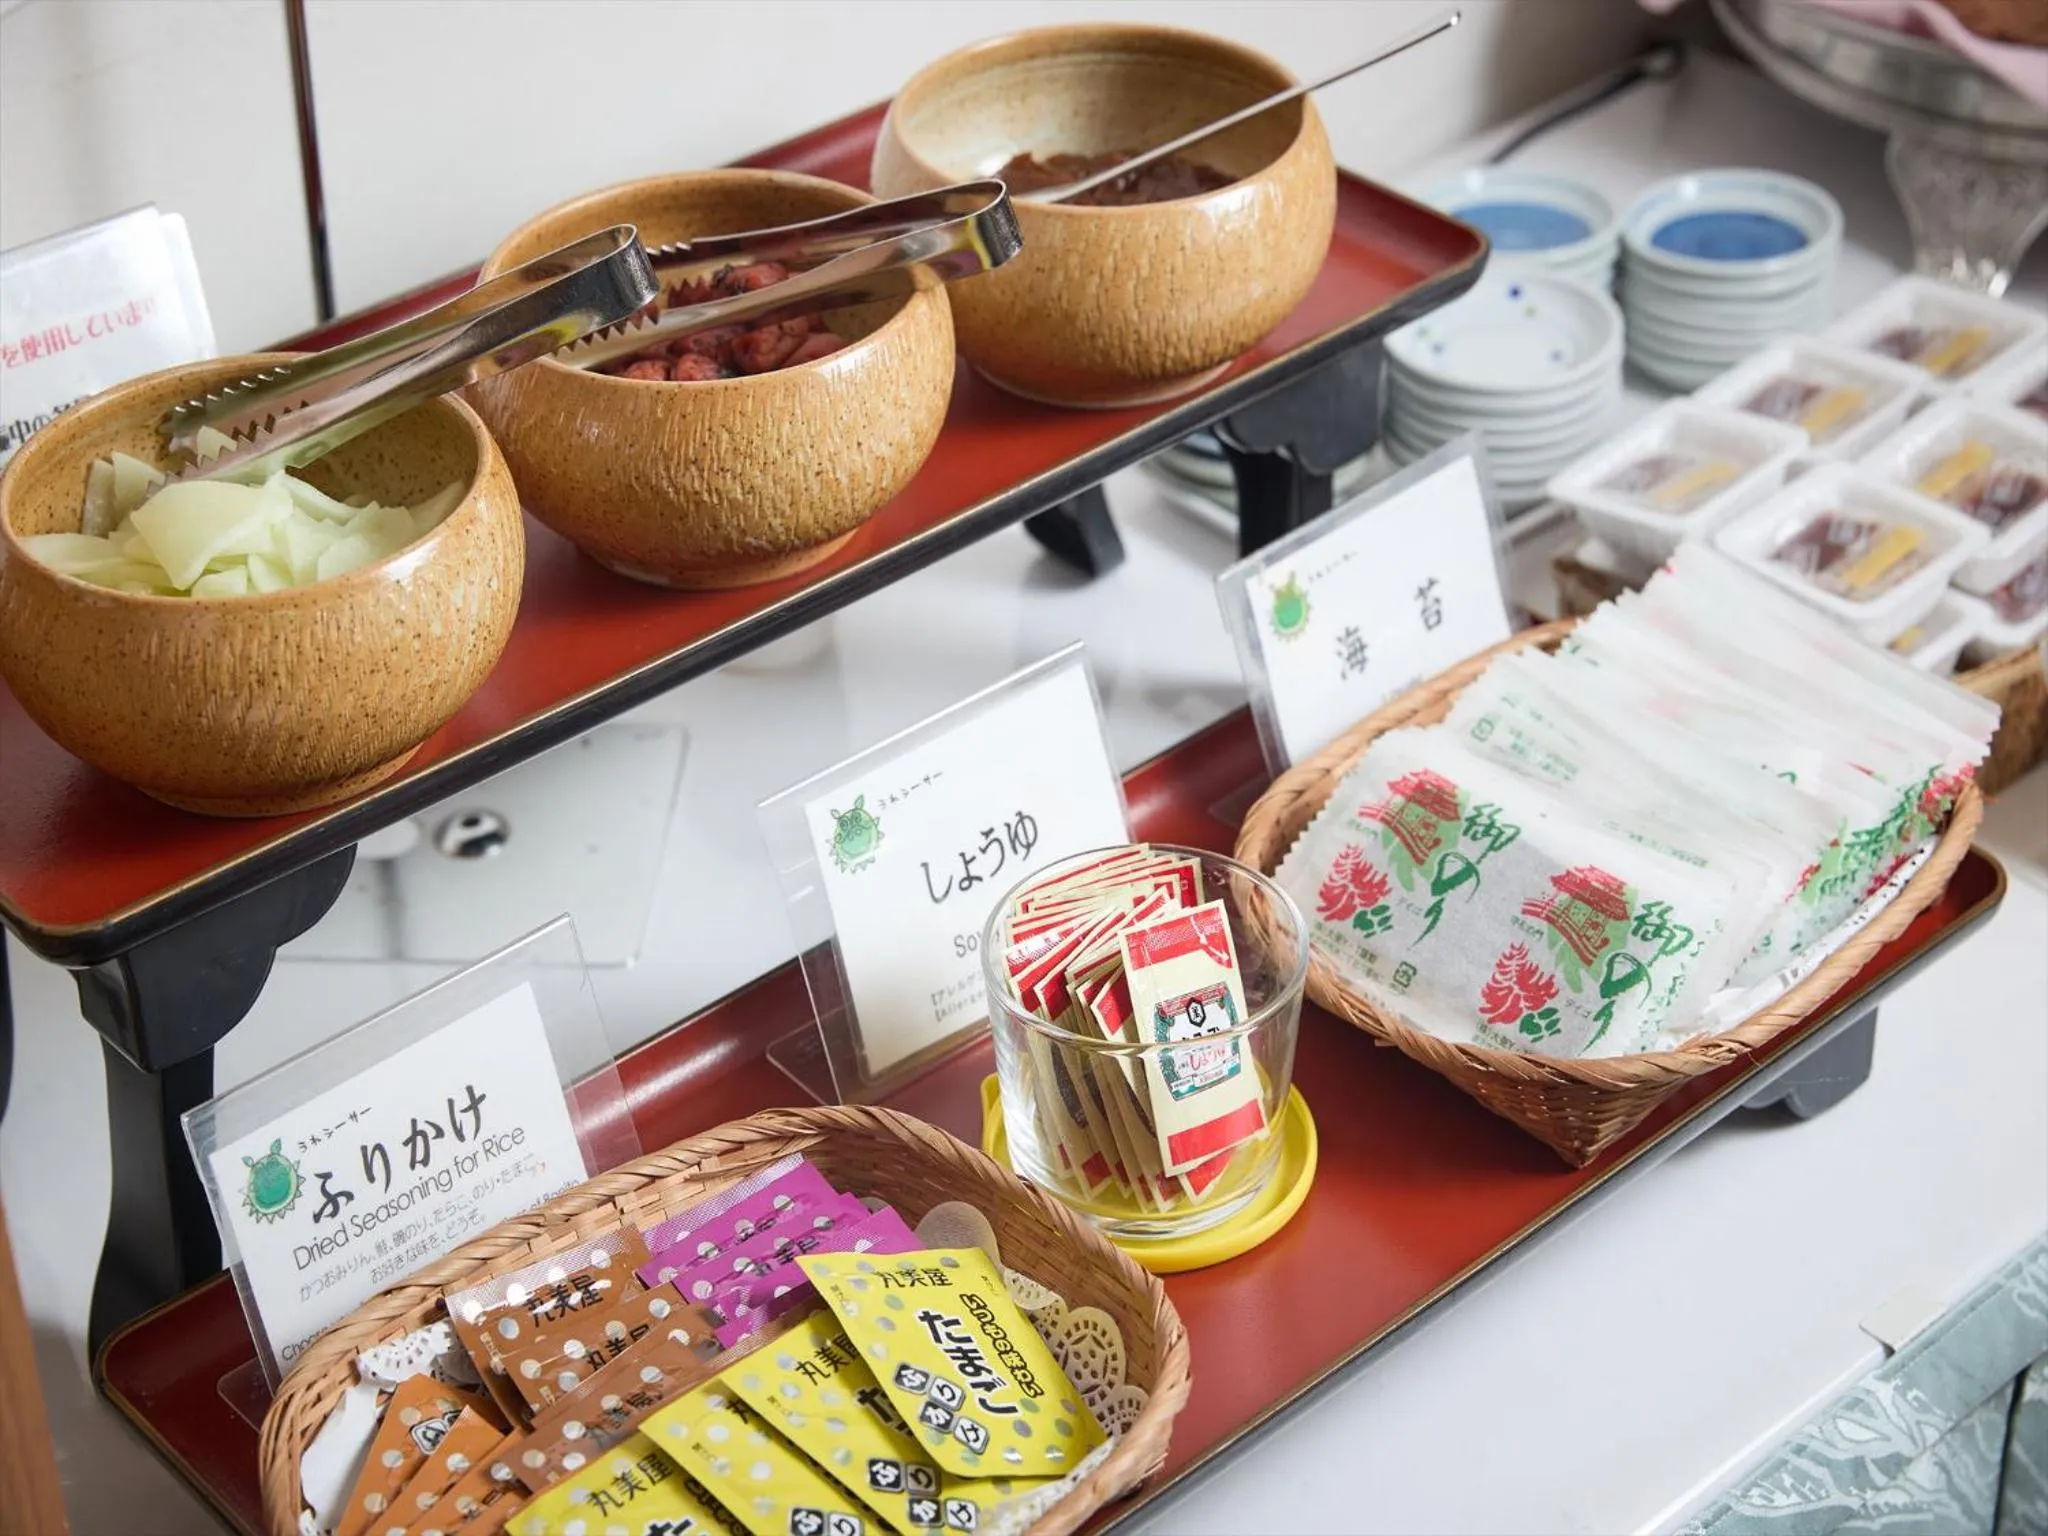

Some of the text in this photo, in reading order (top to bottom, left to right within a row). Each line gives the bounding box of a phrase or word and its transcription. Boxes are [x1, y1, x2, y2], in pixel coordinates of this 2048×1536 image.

[920, 811, 1039, 905] しょうゆ
[292, 1222, 350, 1271] Dried
[350, 1168, 453, 1238] Seasoning
[454, 1150, 479, 1178] for
[482, 1127, 525, 1162] Rice
[312, 1084, 487, 1225] ふりかけ
[872, 1268, 954, 1289] 丸美屋
[916, 1310, 1019, 1414] たまご
[959, 1293, 1045, 1398] いつもの味わい
[586, 1453, 673, 1518] 丸美屋
